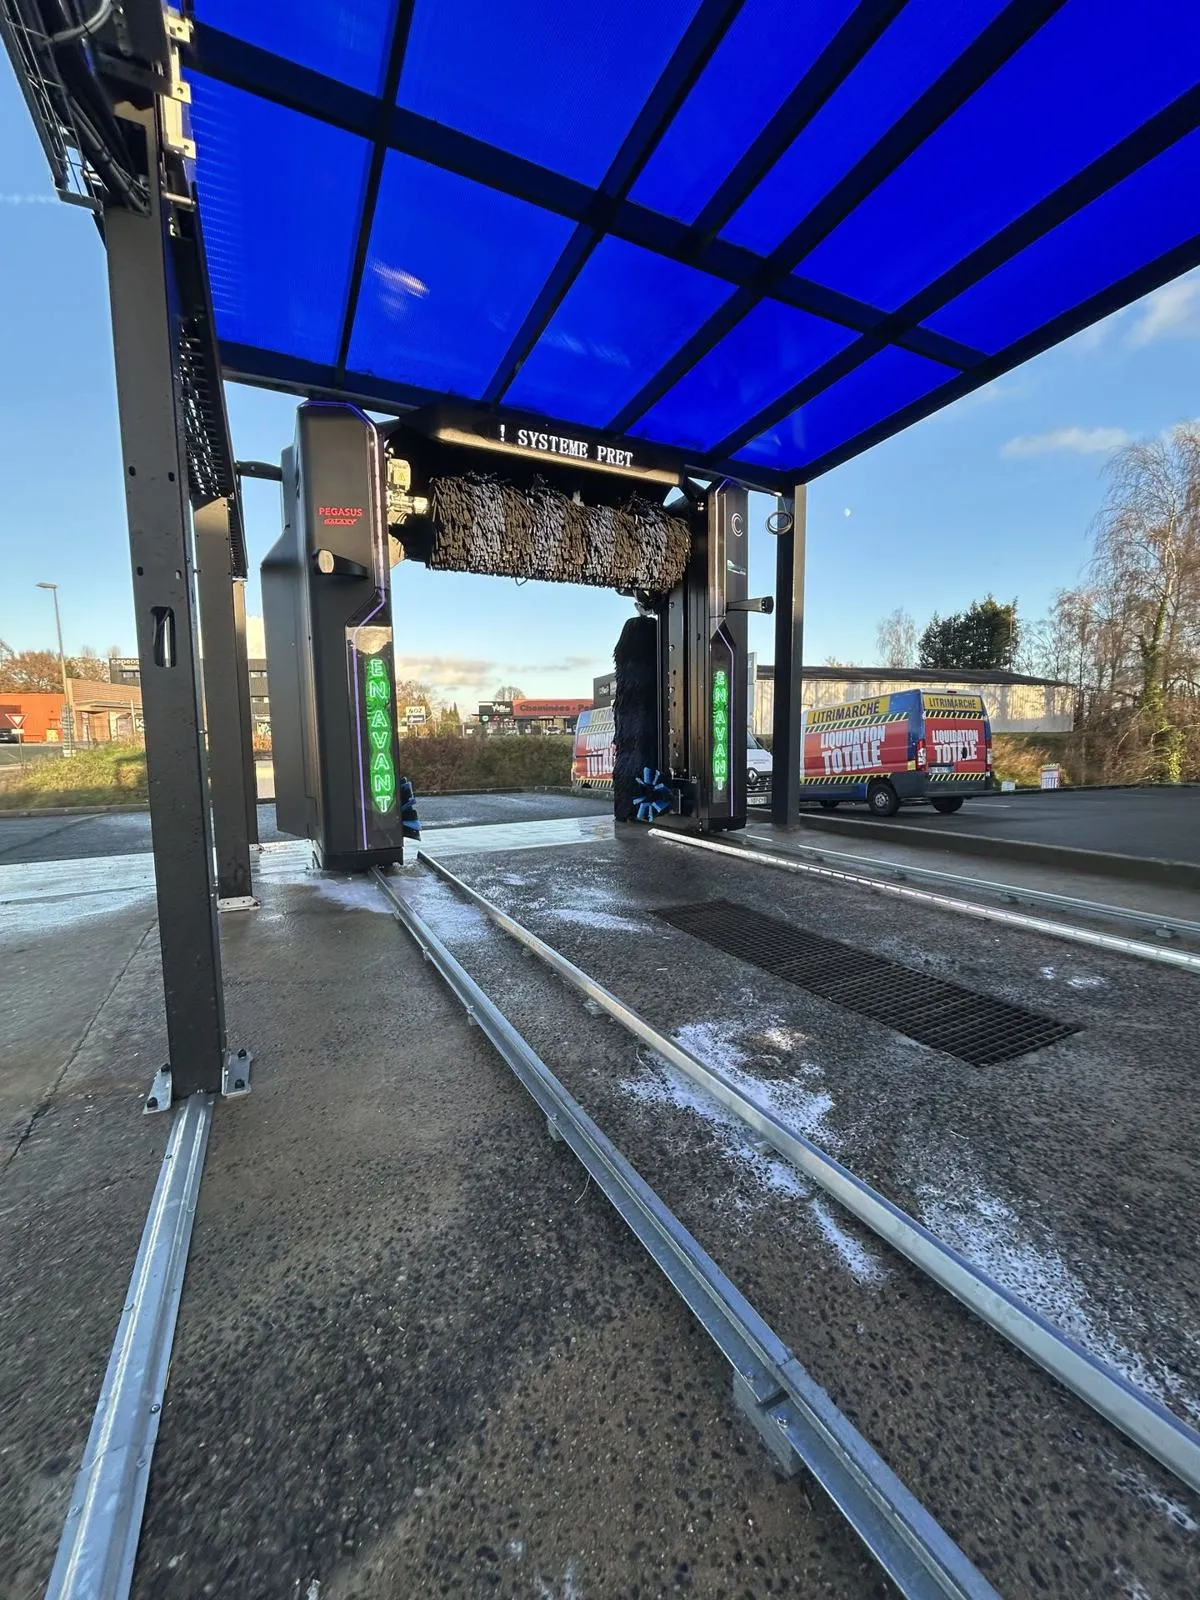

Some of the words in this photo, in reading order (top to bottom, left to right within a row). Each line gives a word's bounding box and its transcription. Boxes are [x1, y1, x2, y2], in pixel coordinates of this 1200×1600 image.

[518, 429, 589, 459] SYSTEME
[597, 445, 634, 467] PRET
[319, 507, 363, 517] PEGASUS
[369, 659, 386, 699] EN
[715, 671, 727, 701] EN
[715, 713, 728, 791] AVANT
[820, 725, 886, 749] LIQUIDATION
[932, 729, 979, 744] LIQUIDATION
[935, 741, 978, 763] TOTALE
[371, 709, 393, 813] AVANT
[822, 740, 882, 775] TOTALE
